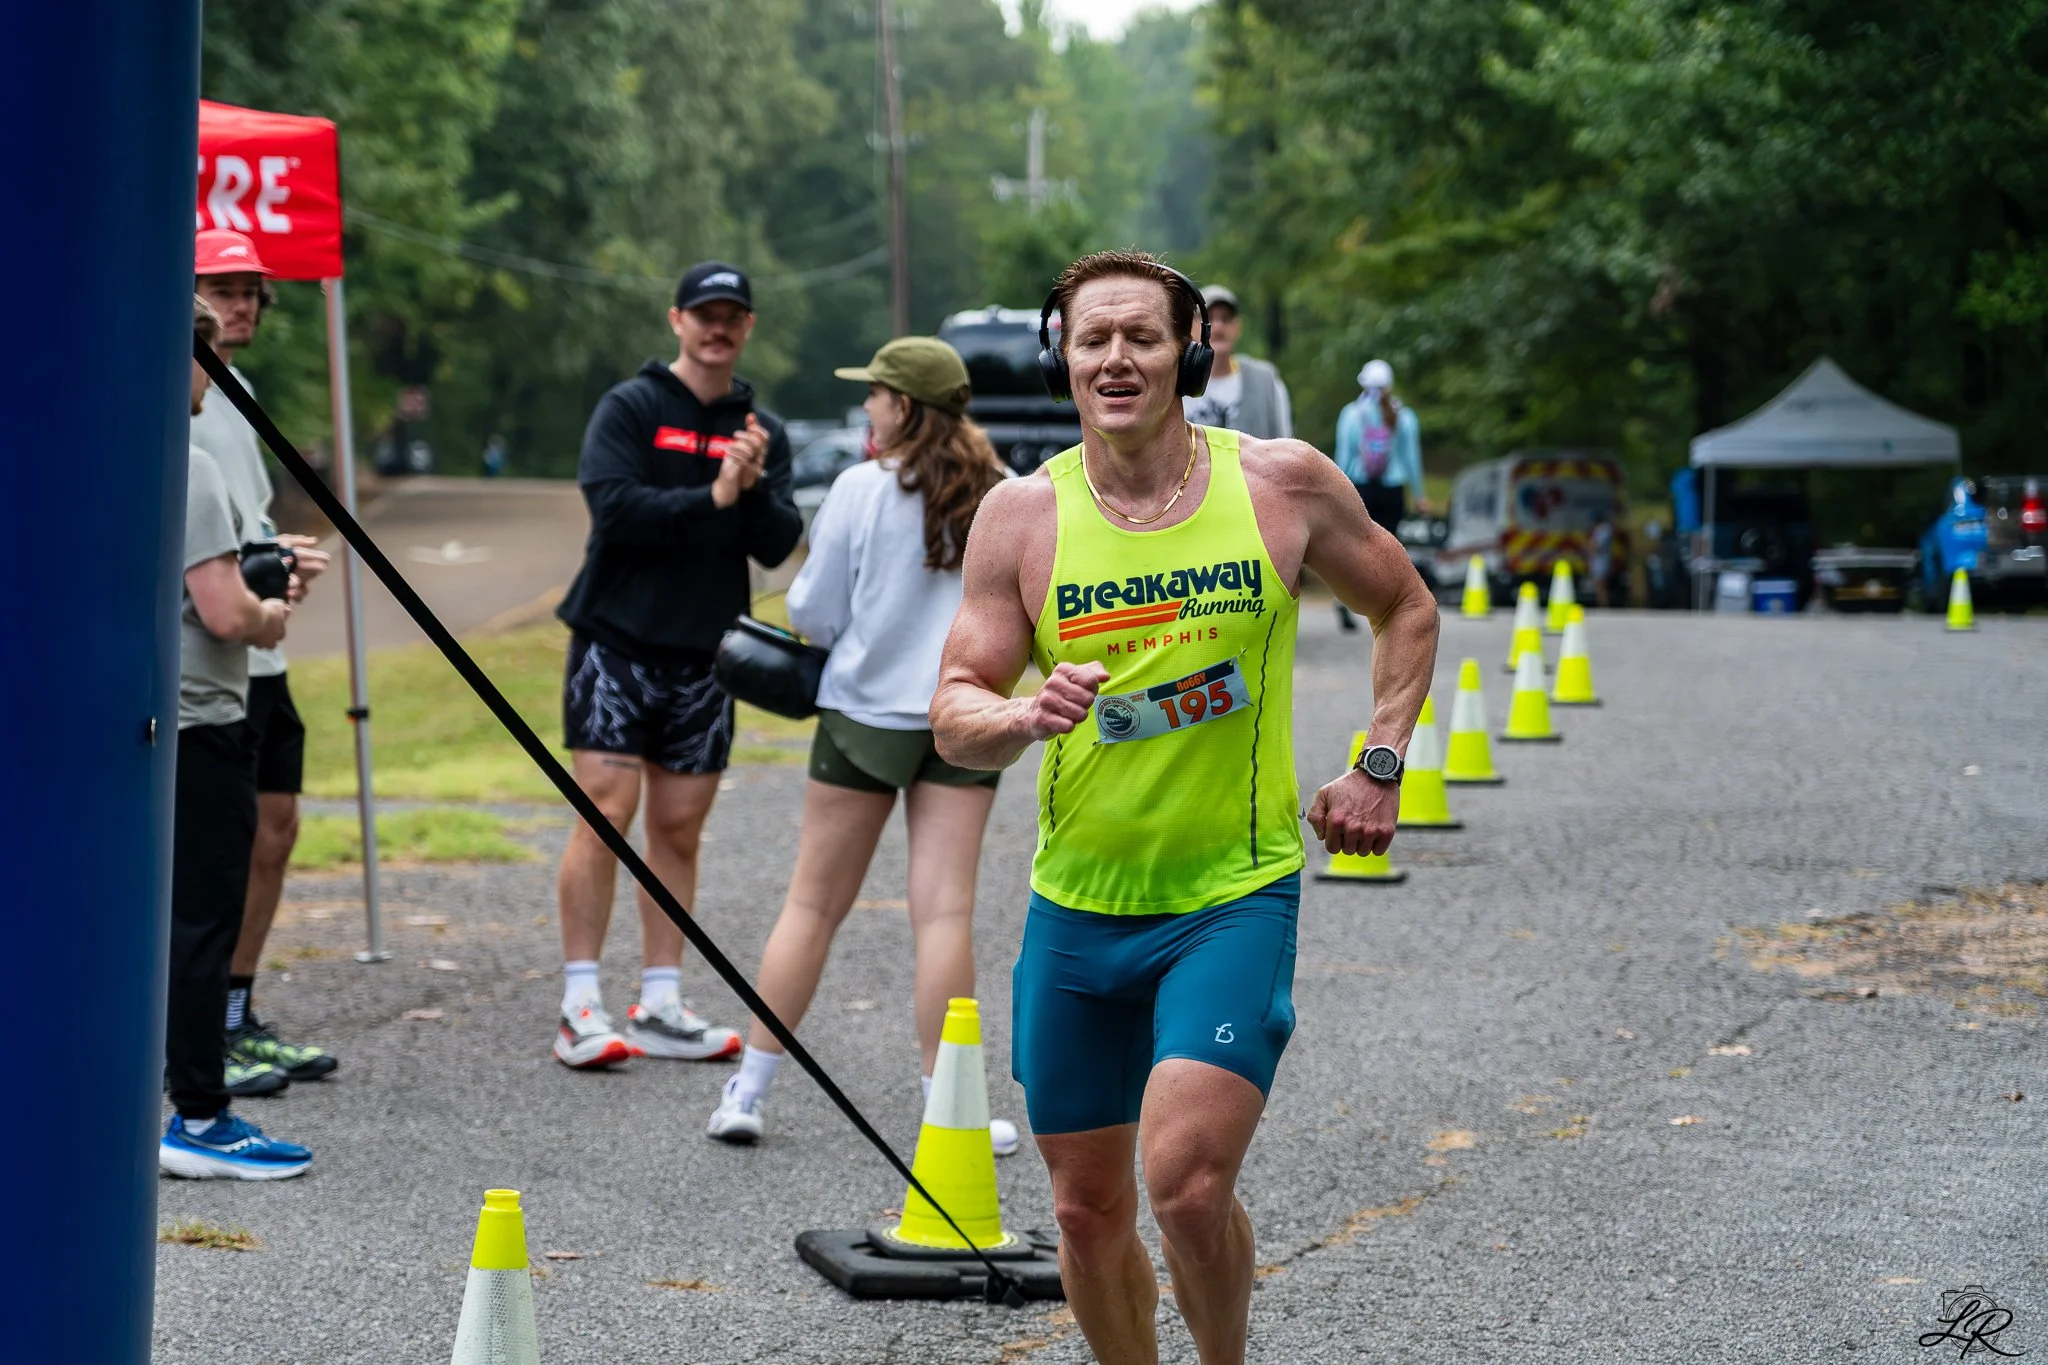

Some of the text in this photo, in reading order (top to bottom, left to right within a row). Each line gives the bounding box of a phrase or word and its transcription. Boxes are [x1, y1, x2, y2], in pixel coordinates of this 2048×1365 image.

[197, 154, 293, 234] RE
[1056, 559, 1263, 620] Breakaway
[1178, 591, 1266, 620] Running
[1107, 627, 1219, 656] MEMPHIS
[1158, 680, 1233, 730] 195
